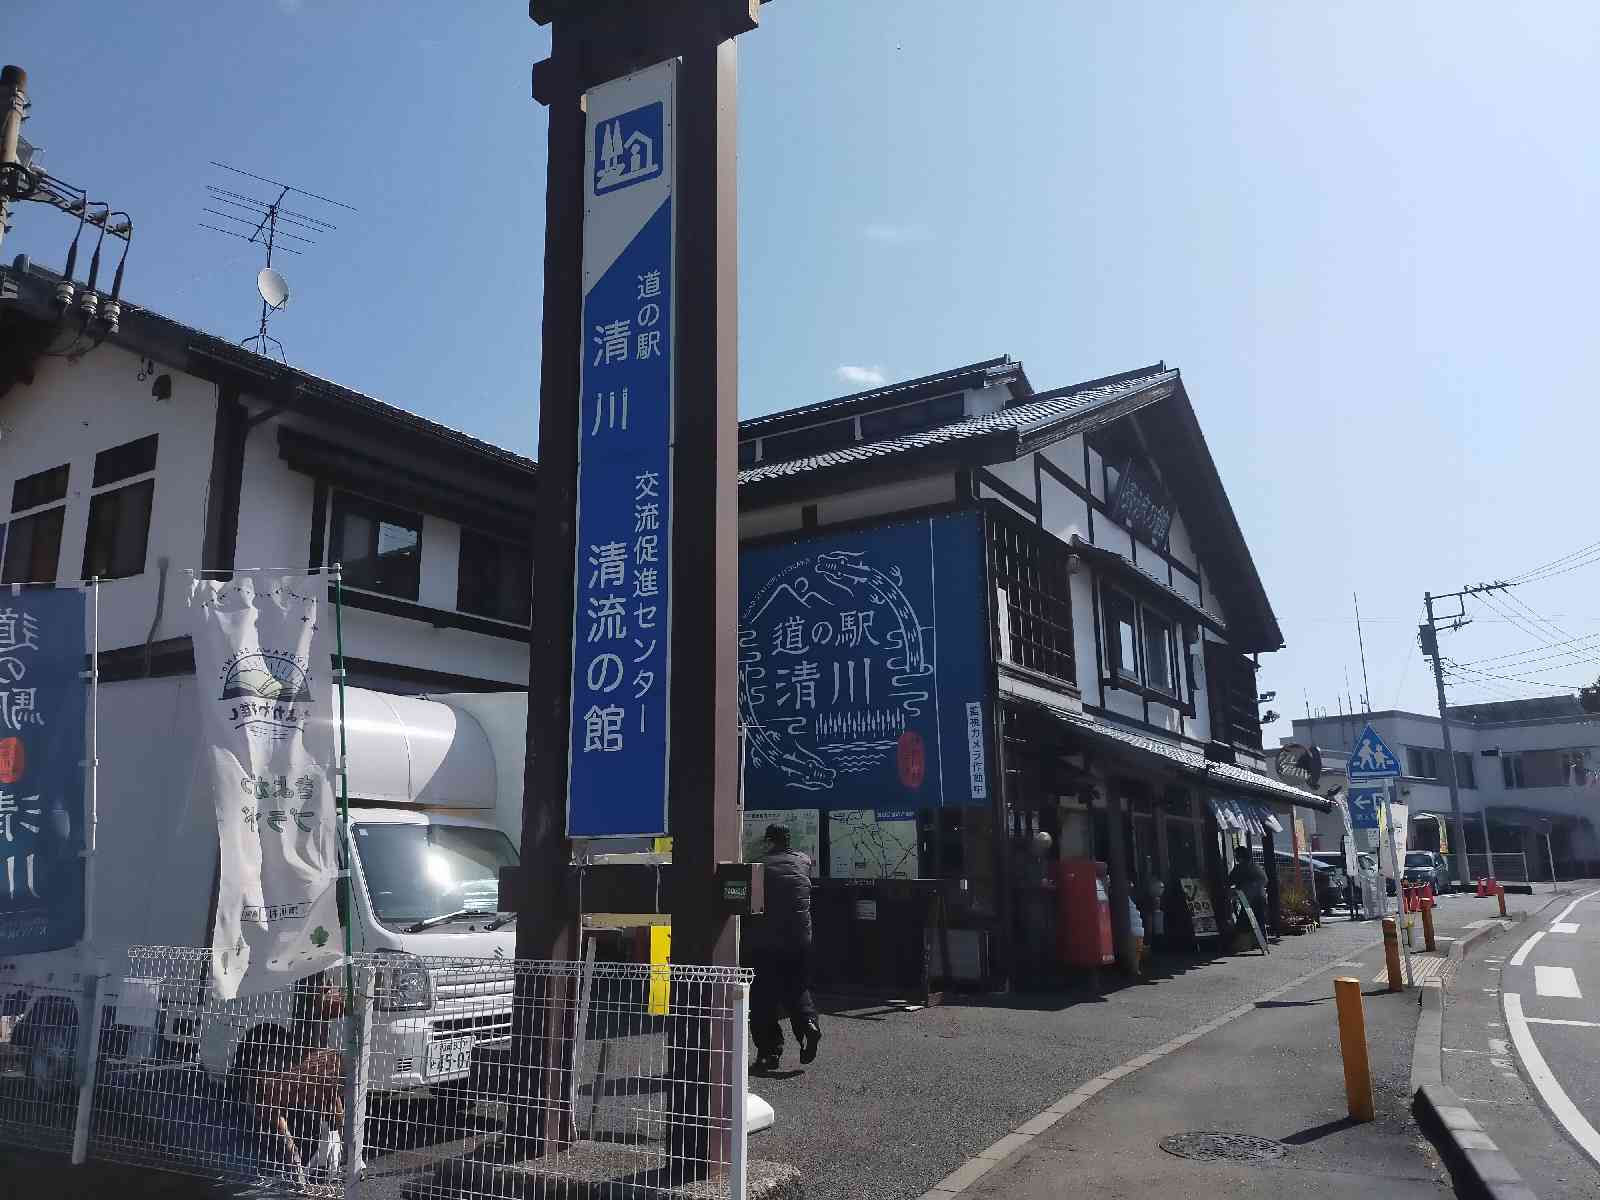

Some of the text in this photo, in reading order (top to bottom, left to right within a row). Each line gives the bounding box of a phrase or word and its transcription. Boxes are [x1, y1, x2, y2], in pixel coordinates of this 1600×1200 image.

[636, 270, 662, 360] 道の駅
[592, 318, 631, 436] 清川
[583, 541, 629, 752] 清流の館
[632, 470, 660, 733] 交流促進センター
[771, 610, 881, 656] 道の駅
[775, 658, 871, 710] 清川
